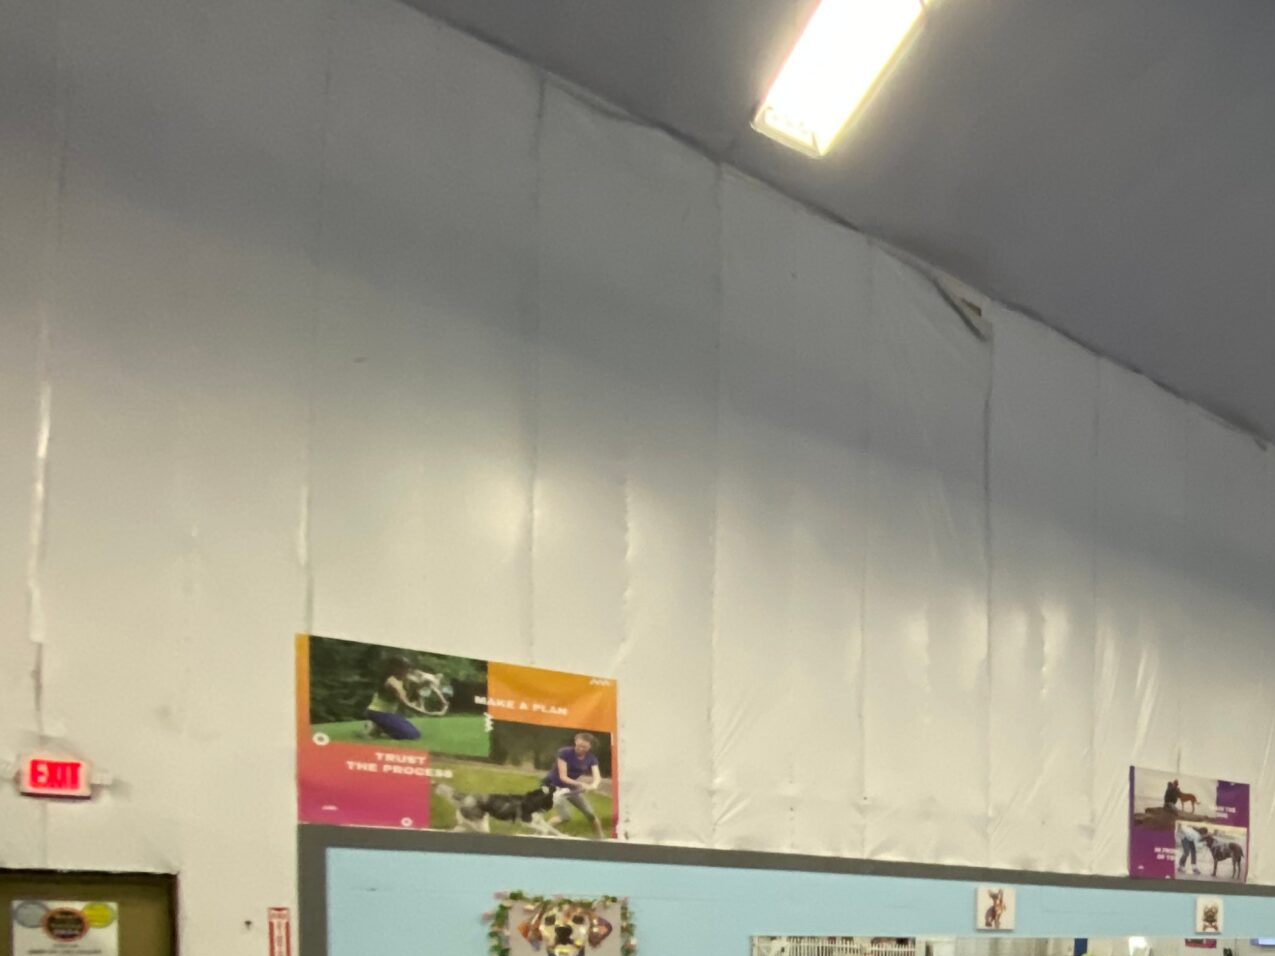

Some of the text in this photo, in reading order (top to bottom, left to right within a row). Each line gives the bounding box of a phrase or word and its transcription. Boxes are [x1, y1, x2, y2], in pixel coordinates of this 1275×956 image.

[474, 695, 568, 716] MAKE A PLAN
[375, 752, 426, 765] TRUST
[30, 759, 81, 790] EXIT
[346, 760, 453, 778] THE PROCESS
